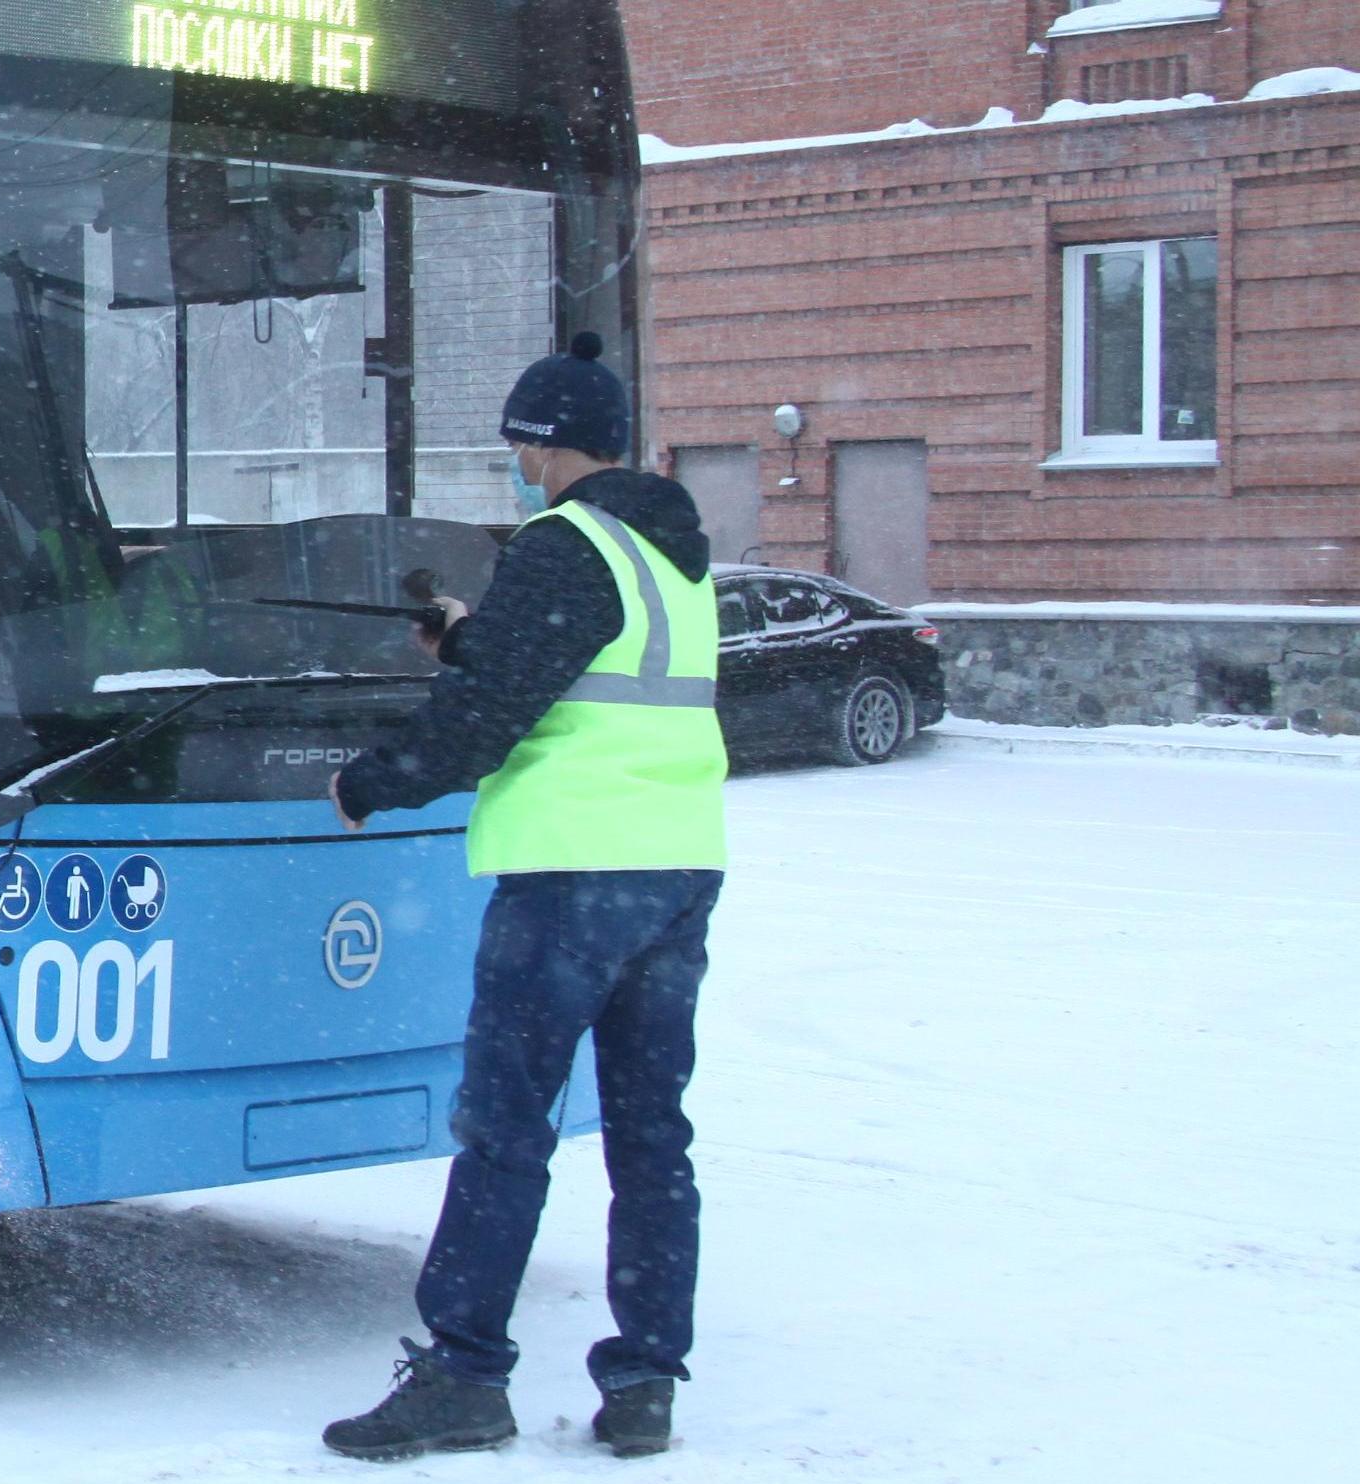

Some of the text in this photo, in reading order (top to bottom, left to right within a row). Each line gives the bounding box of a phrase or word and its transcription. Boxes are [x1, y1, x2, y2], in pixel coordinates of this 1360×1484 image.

[132, 5, 374, 93] ПОСАДКИ НЕТ
[16, 939, 174, 1064] 001
